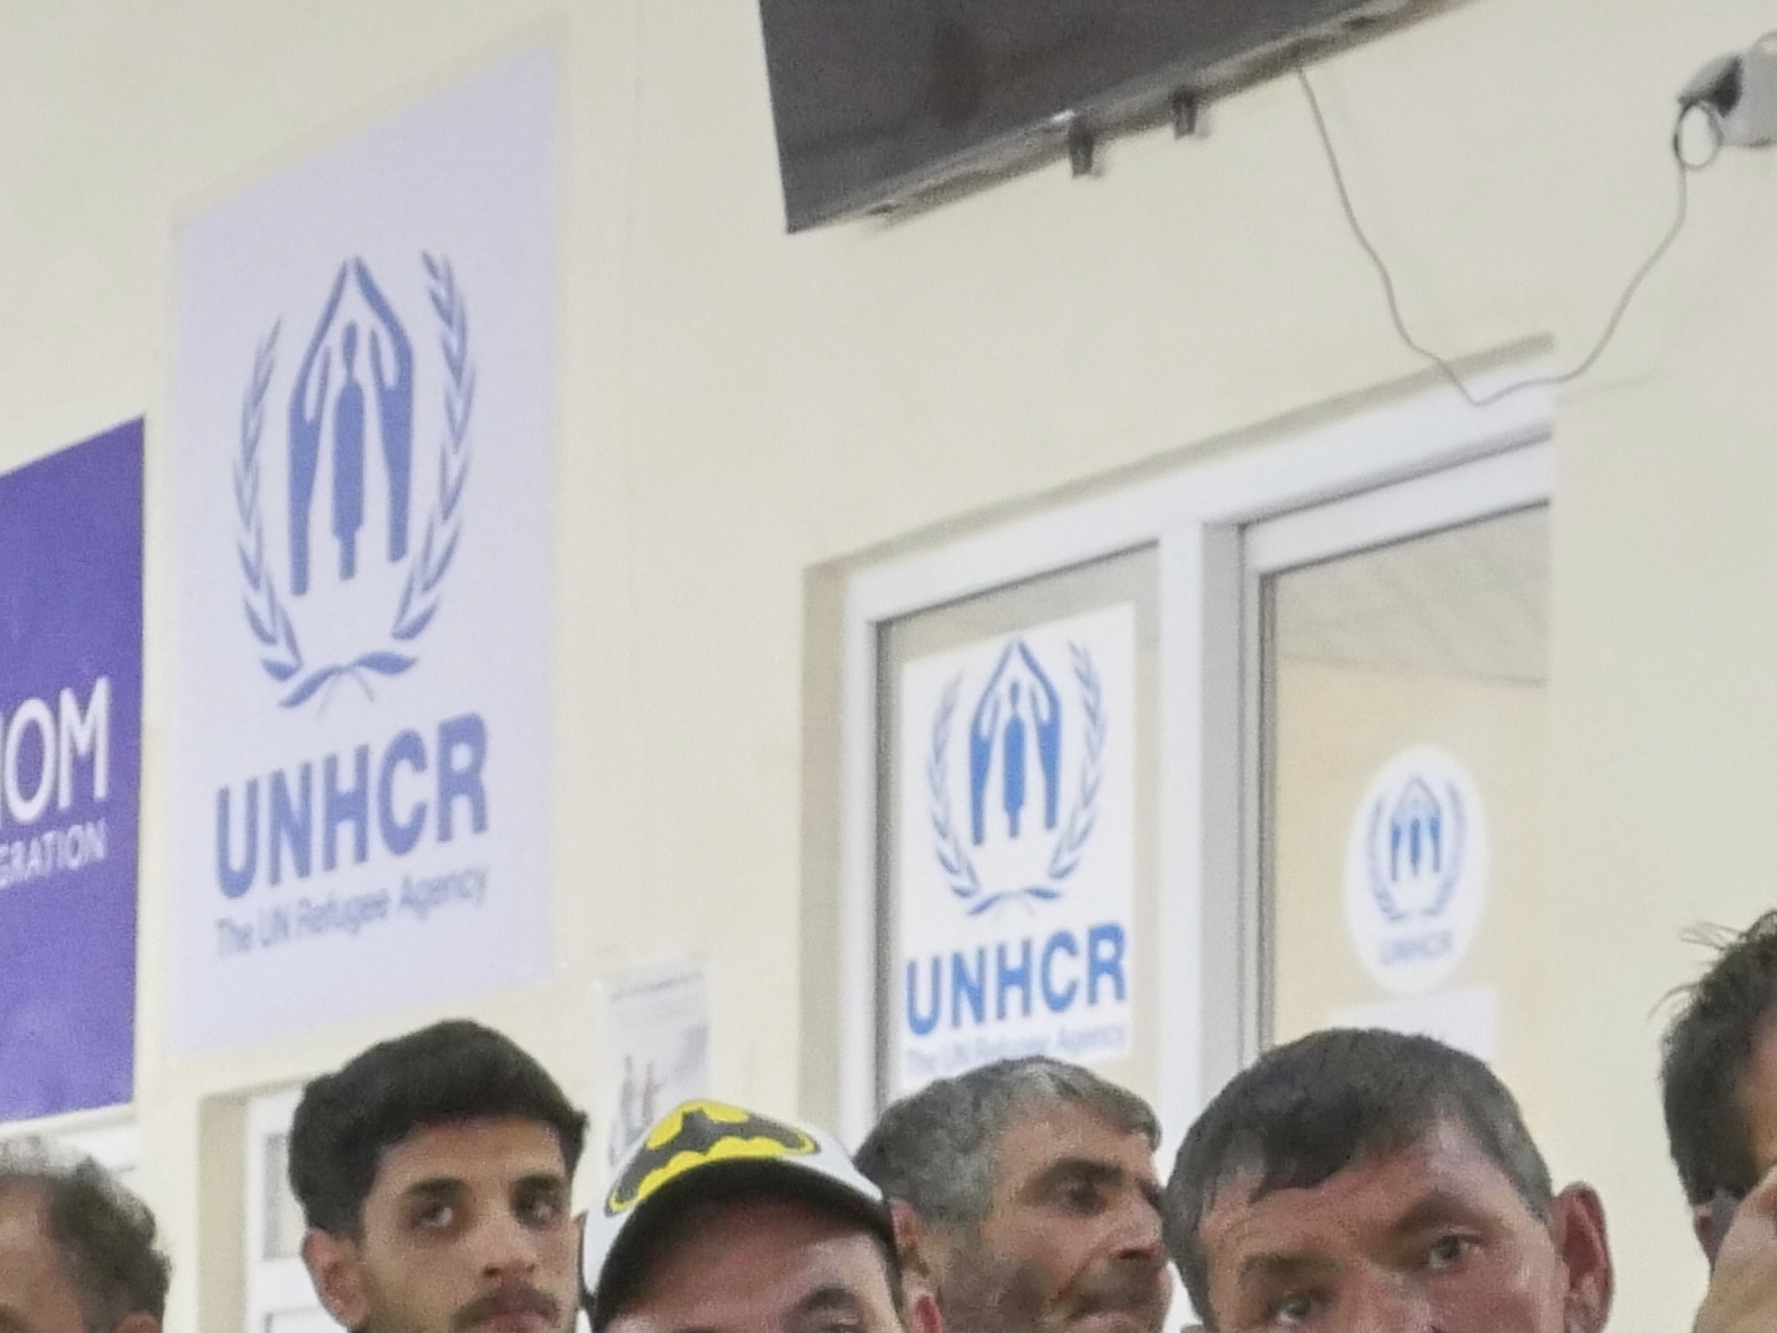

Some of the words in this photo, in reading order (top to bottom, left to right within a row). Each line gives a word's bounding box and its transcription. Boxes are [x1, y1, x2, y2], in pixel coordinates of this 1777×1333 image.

[216, 712, 488, 899] UNHCR
[400, 866, 488, 920] Agency
[906, 922, 1126, 1036] UNHCR
